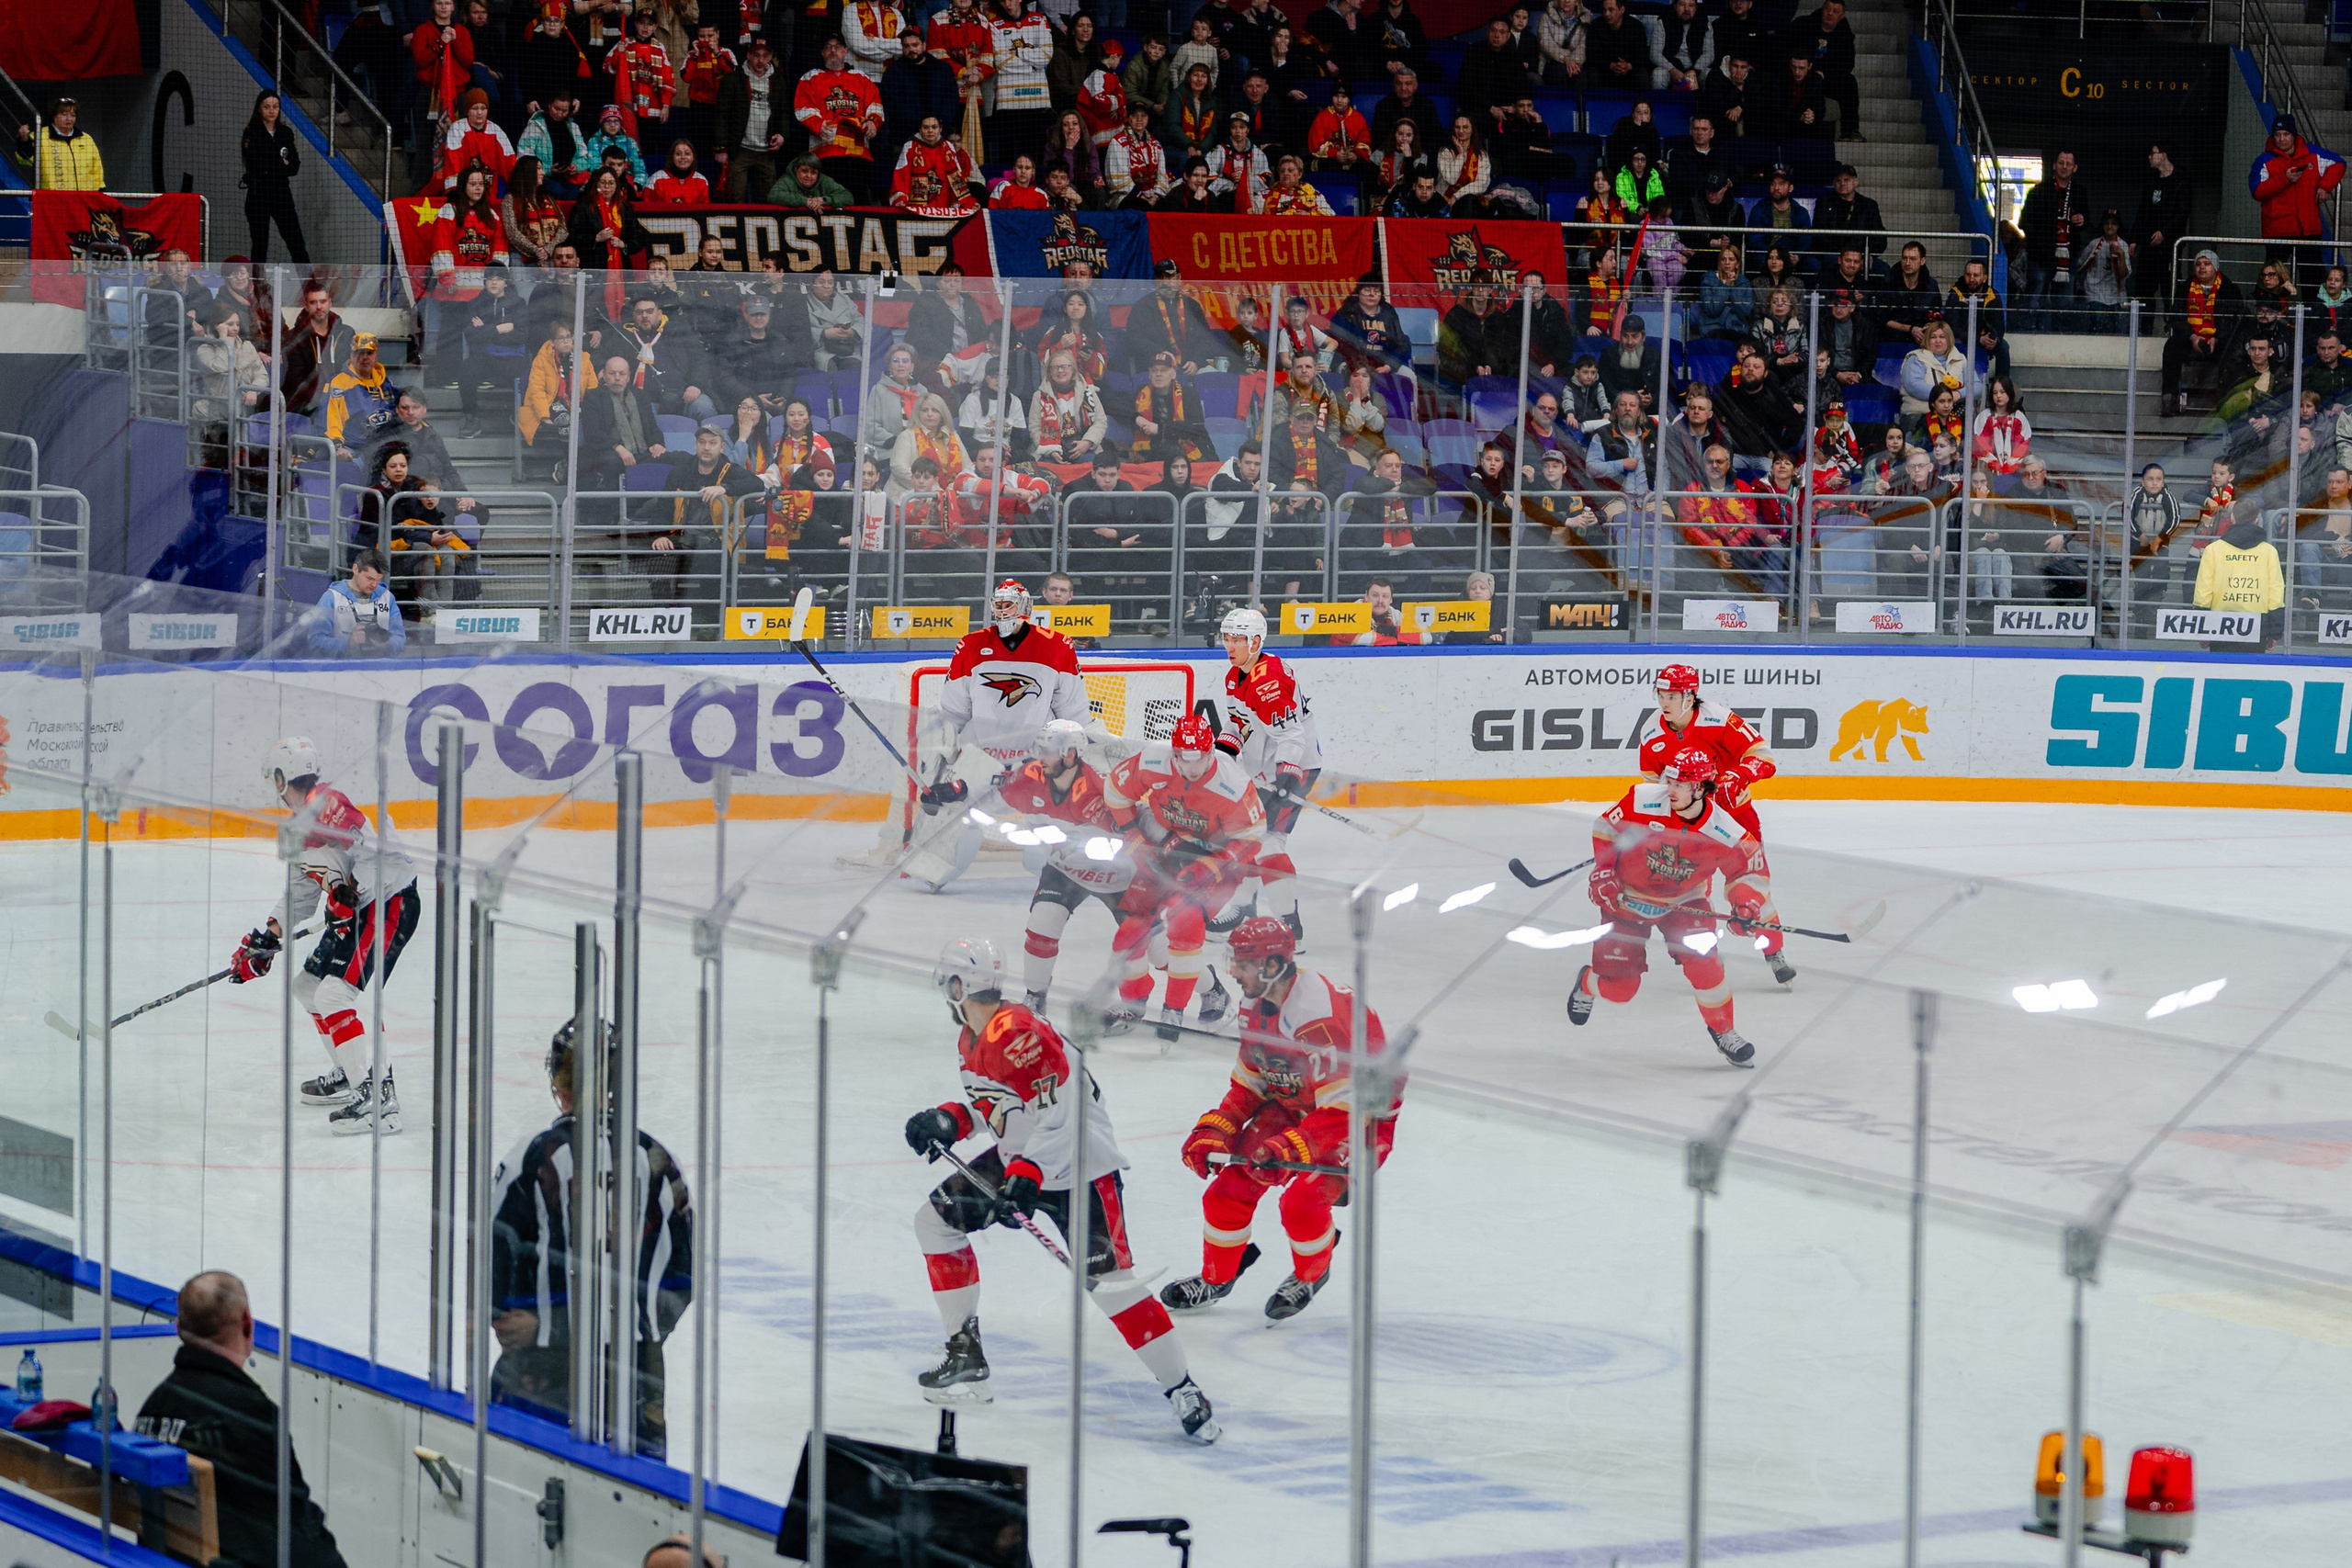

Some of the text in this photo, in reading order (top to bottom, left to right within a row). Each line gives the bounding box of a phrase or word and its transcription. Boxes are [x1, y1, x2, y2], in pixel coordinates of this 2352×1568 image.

[1970, 75, 2038, 85] СЕКТОР
[2121, 80, 2189, 91] SECTOR
[1041, 245, 1109, 273] REDSTAR
[1192, 228, 1339, 274] С ДЕТСТВА
[1433, 267, 1520, 292] REDAR
[2225, 554, 2259, 562] SAFETY
[2222, 592, 2261, 603] SAFETY
[378, 602, 390, 613] 84
[1438, 611, 1476, 622] БАНК
[1549, 604, 1620, 628] МАТЧ!
[455, 616, 521, 634] SIBUR
[595, 615, 685, 635] KHL.RU
[912, 616, 954, 628] БАНК
[1053, 615, 1094, 626] БАНК
[1317, 613, 1357, 624] БАНК
[1714, 613, 1737, 622] АВТО
[1720, 620, 1748, 629] РАДИО
[1869, 615, 1893, 624] АВТО
[1874, 622, 1904, 631] РАДИО
[1999, 611, 2089, 631] KHL.RU
[2162, 615, 2255, 637] KHL.RU
[14, 622, 81, 643] SIBUR
[150, 623, 218, 640] SIBUR
[1524, 668, 1821, 687] АВТОМОБИЫЕ ШИНЫ
[1271, 705, 1298, 729] 44
[1318, 797, 1350, 824] CCM
[1646, 854, 1696, 880] REDSTAR
[1307, 1045, 1339, 1082] 27
[1031, 1073, 1058, 1110] 17
